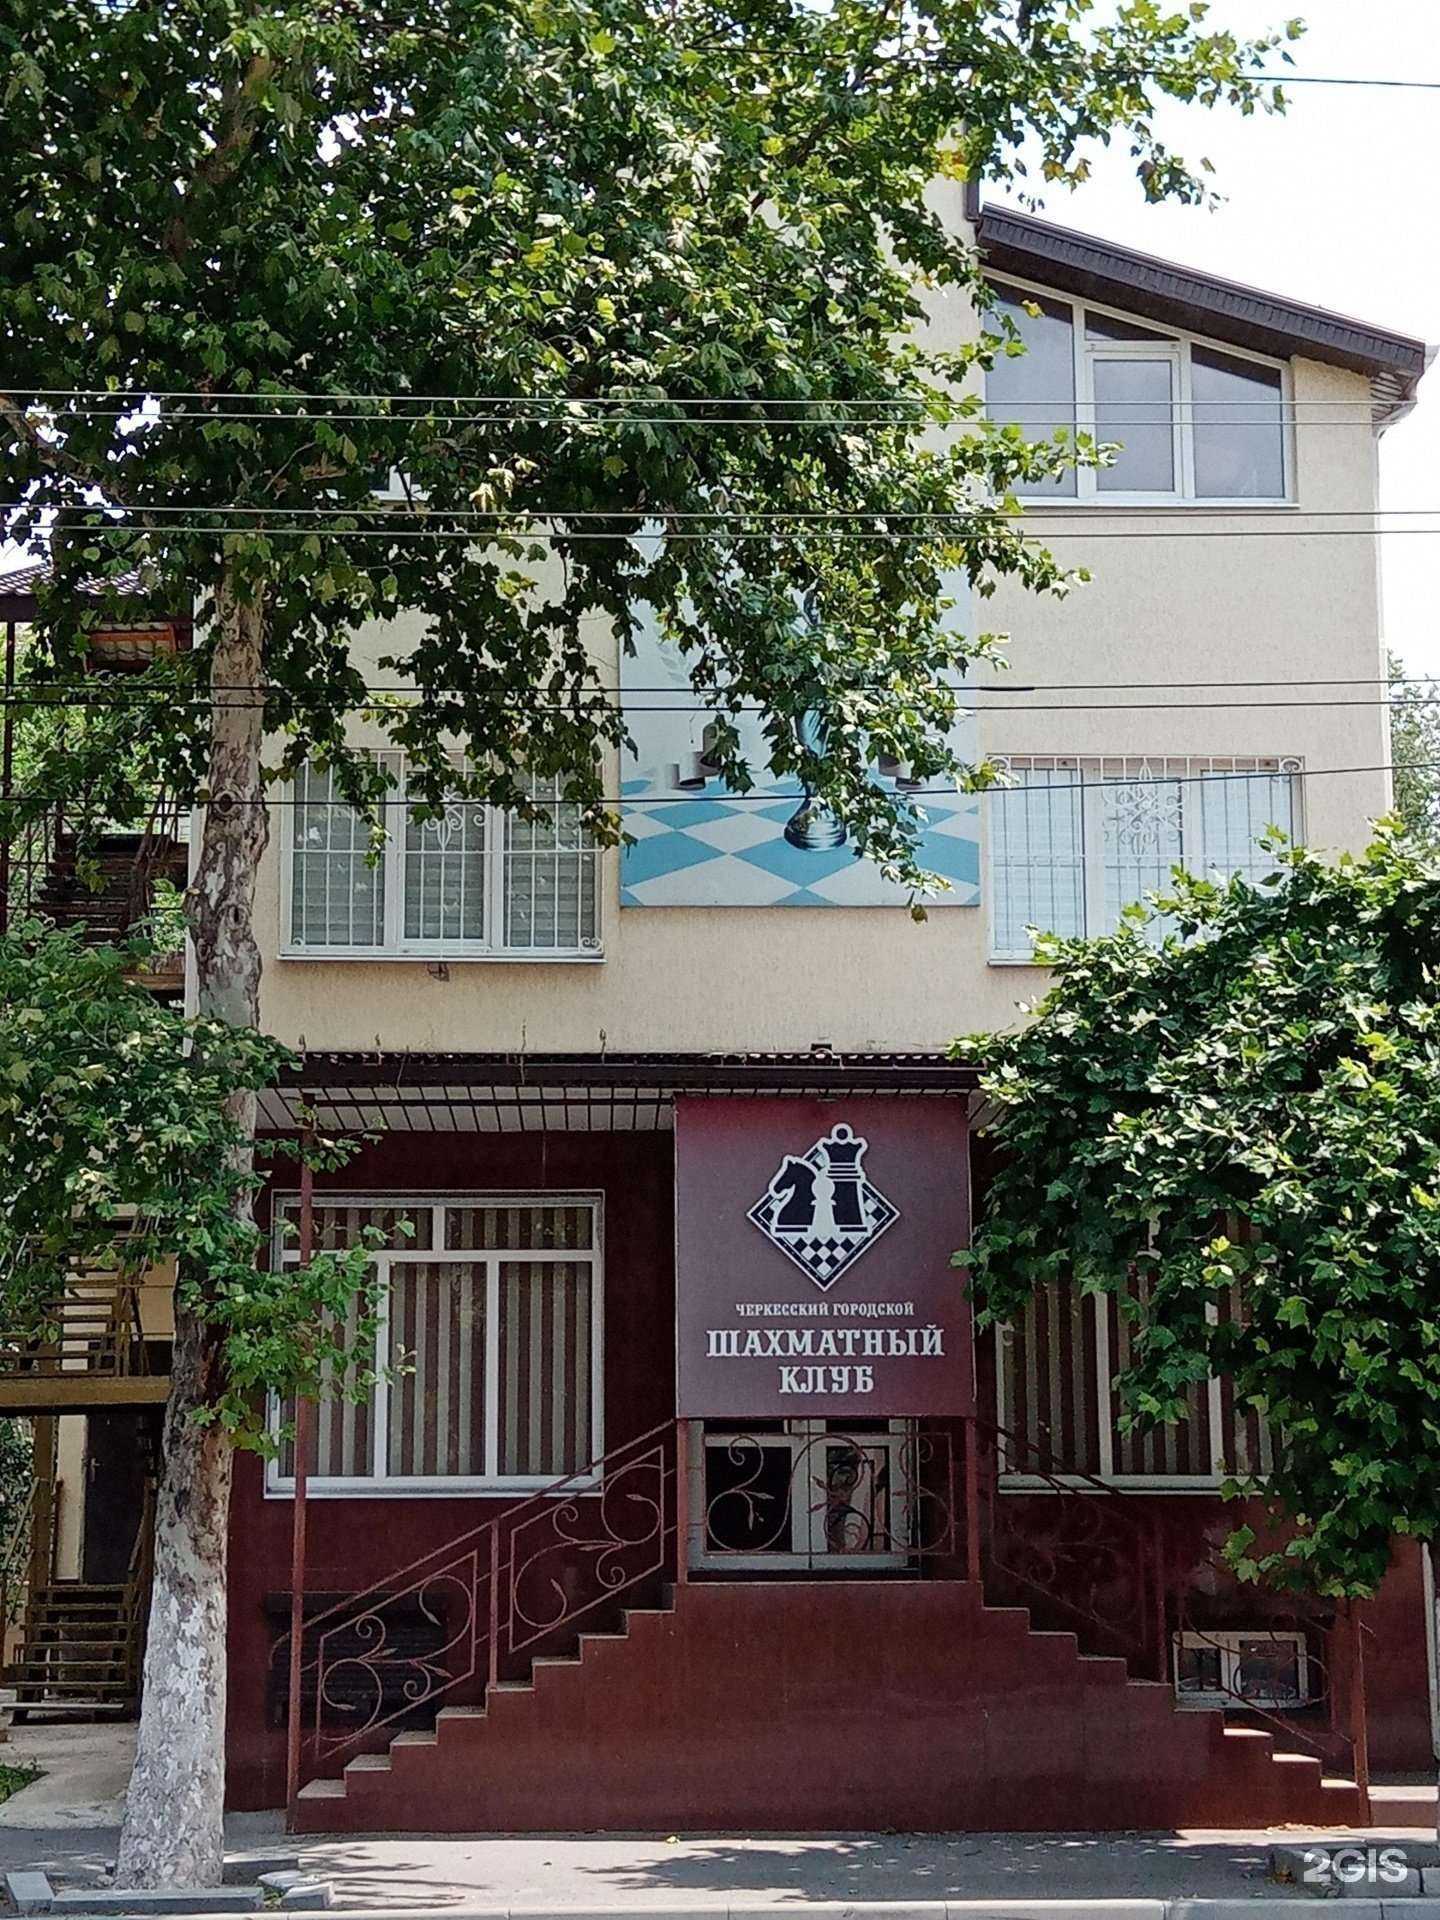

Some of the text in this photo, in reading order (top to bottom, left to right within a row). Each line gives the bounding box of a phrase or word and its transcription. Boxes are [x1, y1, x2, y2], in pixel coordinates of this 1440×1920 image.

[735, 1302, 914, 1318] ЧЕРКЕССКИЙ ГОРОДСКОЙ
[706, 1324, 945, 1357] ШАХМАТНЫЙ
[778, 1366, 874, 1393] КЛУБ
